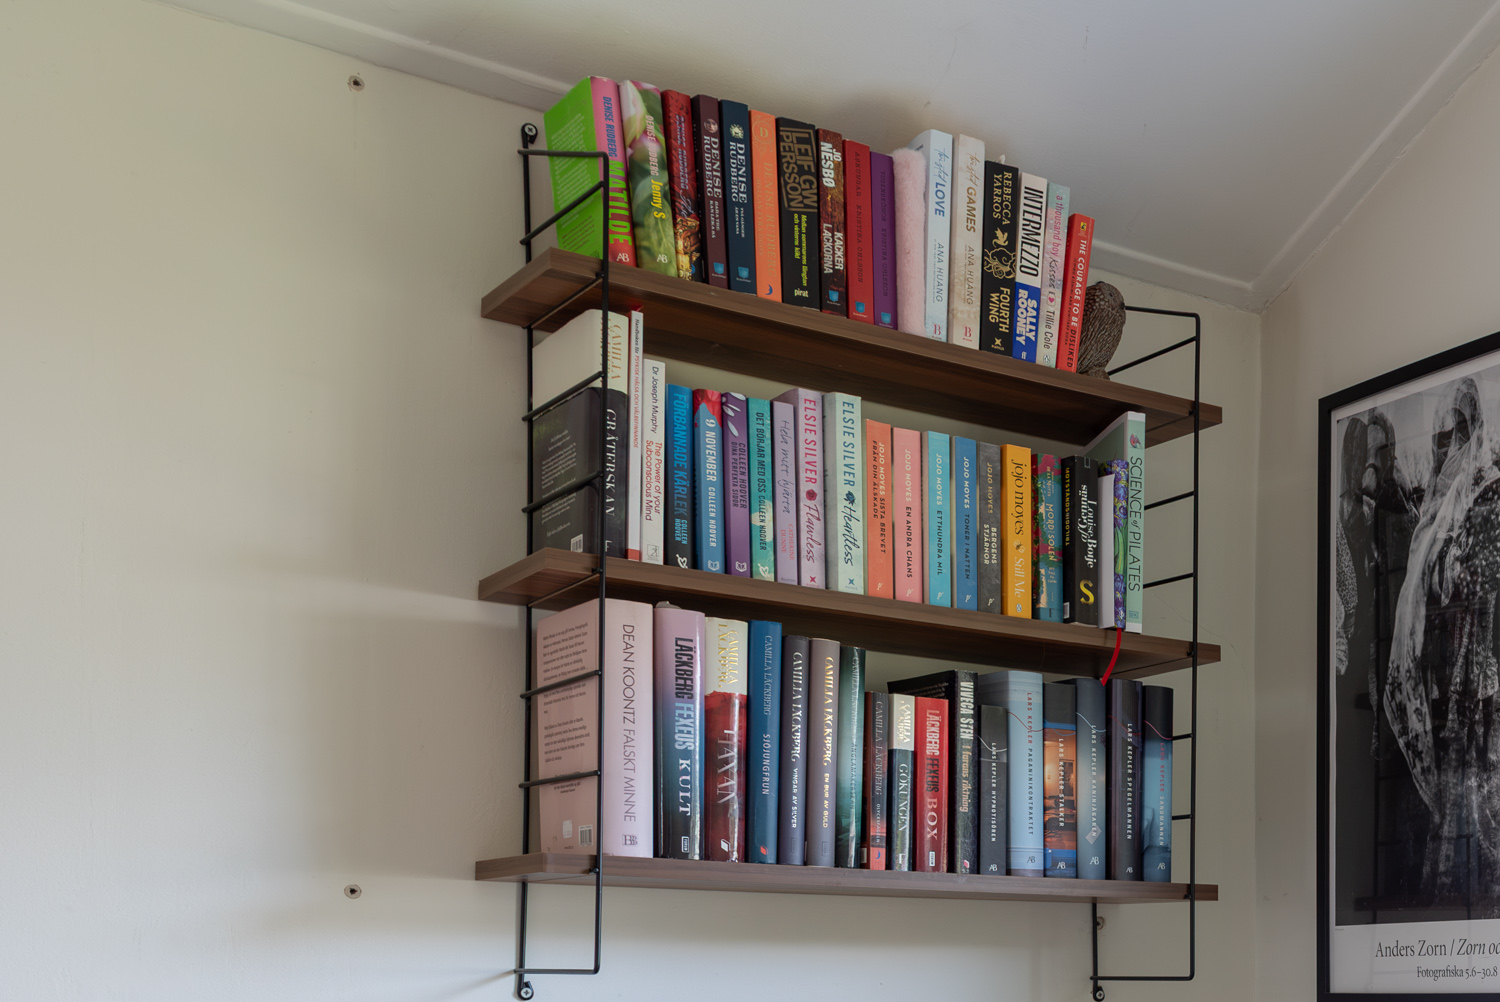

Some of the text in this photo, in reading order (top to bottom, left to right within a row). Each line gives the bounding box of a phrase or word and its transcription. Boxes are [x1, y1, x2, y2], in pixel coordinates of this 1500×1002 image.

[603, 96, 618, 158] DENISE RUDBERG
[704, 136, 722, 198] DENISE RUDBERG
[730, 142, 746, 203] DENISE RUDBERG
[780, 132, 804, 208] PERSSON
[792, 132, 818, 208] LEIF GW
[820, 142, 836, 188] NESBØ
[833, 148, 842, 162] JO
[609, 161, 633, 246] MATILDE
[651, 180, 666, 220] Jenny S
[934, 182, 946, 217] LOVE
[966, 186, 977, 233] GAMES
[992, 174, 1002, 219] YARROS
[1002, 171, 1012, 225] REBECCA
[822, 222, 834, 274] LACKORNA
[834, 232, 844, 270] KACKER
[1019, 186, 1044, 278] INTERMEZZO
[936, 267, 944, 302] HUANG
[989, 292, 1000, 323] WING
[1066, 240, 1087, 368] THE COURAGE TO BE DISLIKED
[999, 287, 1011, 332] FOURTH
[1016, 288, 1028, 346] ROONEY
[1025, 298, 1038, 342] SALLY
[1044, 310, 1056, 350] Tillie Cole
[756, 412, 764, 426] DET
[804, 398, 818, 484] ELSIE SILVER
[654, 442, 662, 458] The
[674, 393, 690, 516] FÖRBANNADE KÄRLEK
[706, 418, 716, 482] 9 NOVEMBER
[756, 428, 766, 458] BÖRJAR
[842, 401, 855, 487] ELSIE SILVER
[645, 440, 654, 498] Subconscious
[654, 486, 662, 494] of
[738, 442, 748, 509] COLLEEN HOOVER
[757, 460, 766, 476] MED
[758, 478, 766, 493] OSS
[708, 487, 716, 518] COLLEEN
[906, 506, 912, 518] EN
[1011, 459, 1027, 536] jojo moyes
[804, 504, 822, 564] Flawless
[842, 505, 860, 566] Heartless
[1128, 456, 1143, 592] SCIENCE of PILATES
[1014, 556, 1026, 598] Still Me
[622, 624, 635, 662] DEAN
[622, 666, 636, 724] KOONTZ
[674, 637, 696, 750] LÄCKBERG FEXEUS
[960, 682, 974, 740] VIVECA STEN
[623, 728, 636, 773] FALSKT
[926, 709, 942, 792] LÄCKBERG FEXEUS
[624, 776, 636, 822] MINNE
[678, 758, 690, 816] KULT
[792, 796, 798, 804] AV
[824, 773, 830, 783] EN
[823, 800, 829, 808] AV
[927, 798, 938, 840] BOX
[1375, 940, 1415, 958] Anders
[1418, 940, 1446, 956] Zorn
[1450, 938, 1455, 956] /
[1456, 938, 1486, 956] Zorn
[1416, 965, 1464, 981] Fotografiska
